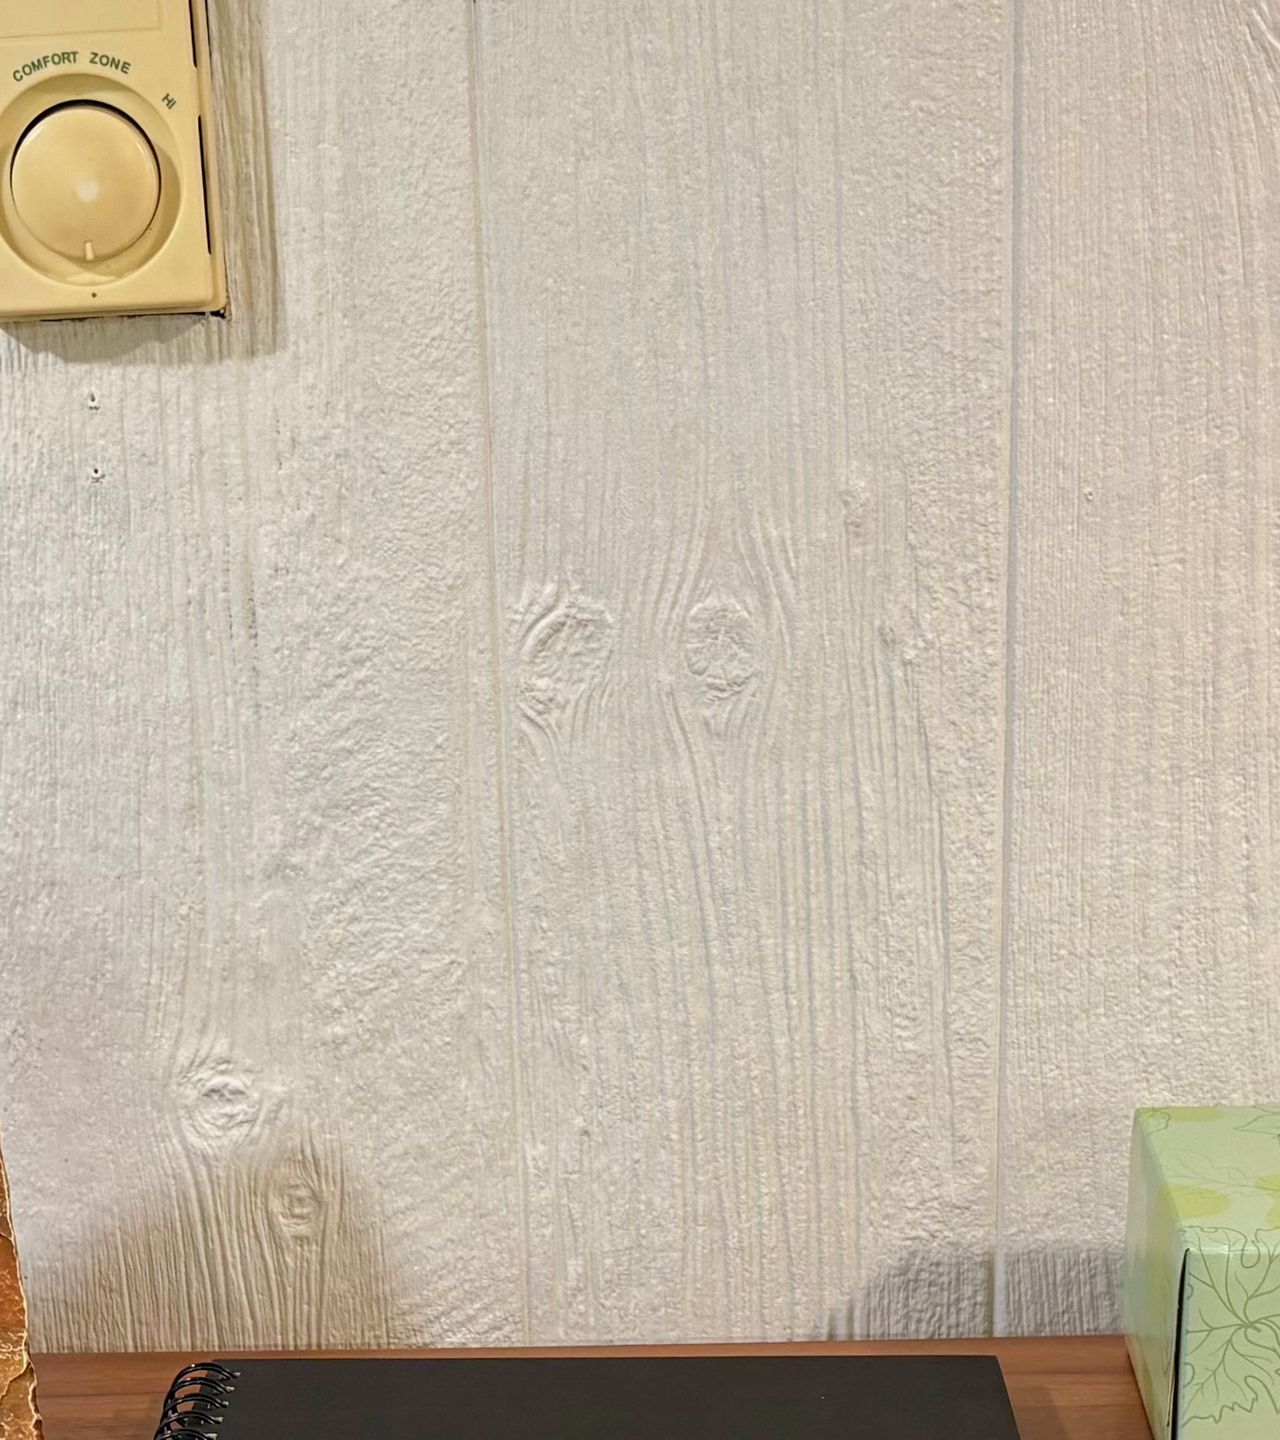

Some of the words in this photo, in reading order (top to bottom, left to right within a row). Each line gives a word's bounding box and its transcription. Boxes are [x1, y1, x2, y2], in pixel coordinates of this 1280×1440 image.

[12, 51, 79, 82] COMFORT
[89, 51, 132, 74] ZONE
[161, 92, 177, 110] HI
